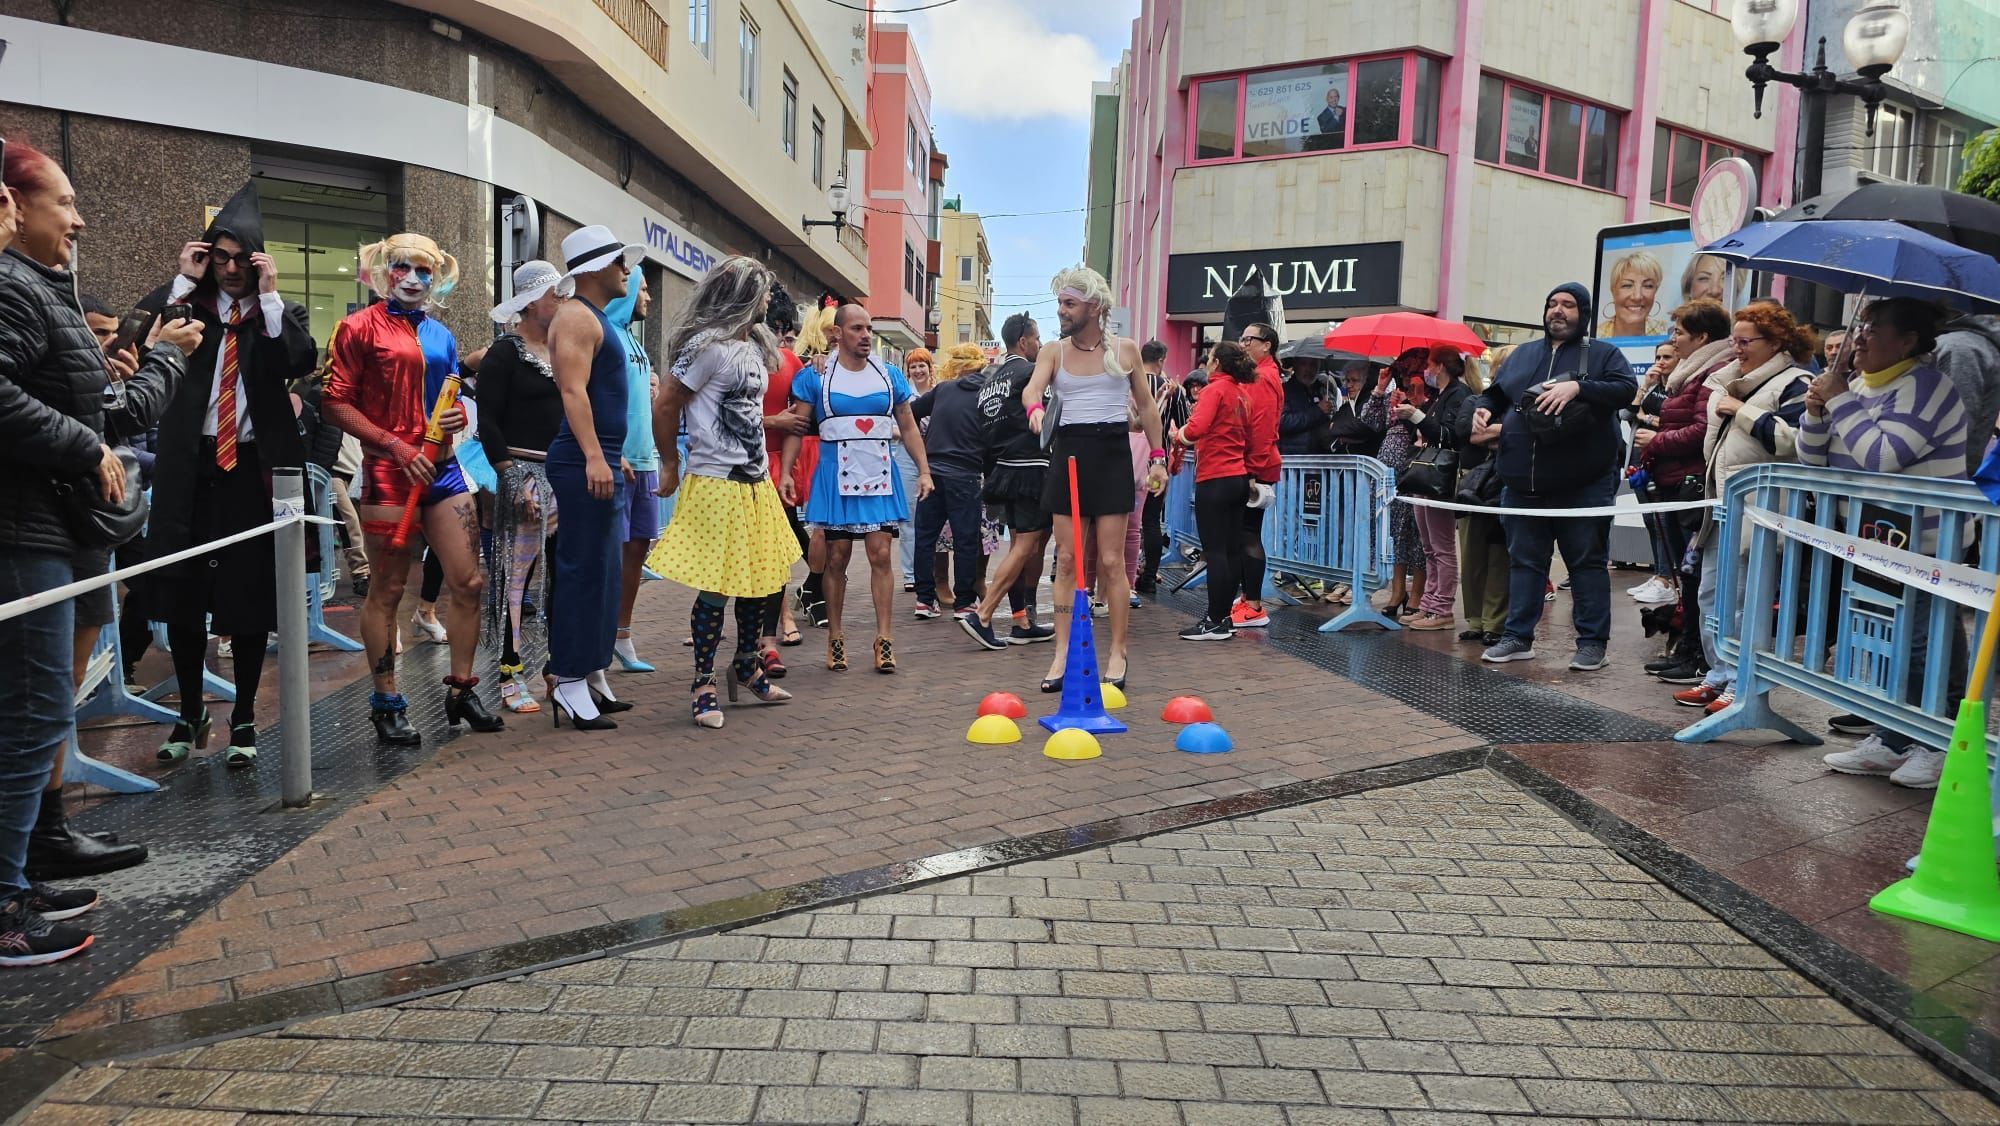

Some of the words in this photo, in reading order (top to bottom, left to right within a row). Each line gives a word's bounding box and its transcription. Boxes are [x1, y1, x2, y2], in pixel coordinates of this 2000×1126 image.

[1257, 87, 1274, 97] 629
[1275, 84, 1292, 95] 861
[1295, 81, 1312, 92] 625
[1247, 117, 1310, 139] VENDE
[643, 217, 717, 273] VITALDENT
[1889, 561, 1912, 576] Ciudad
